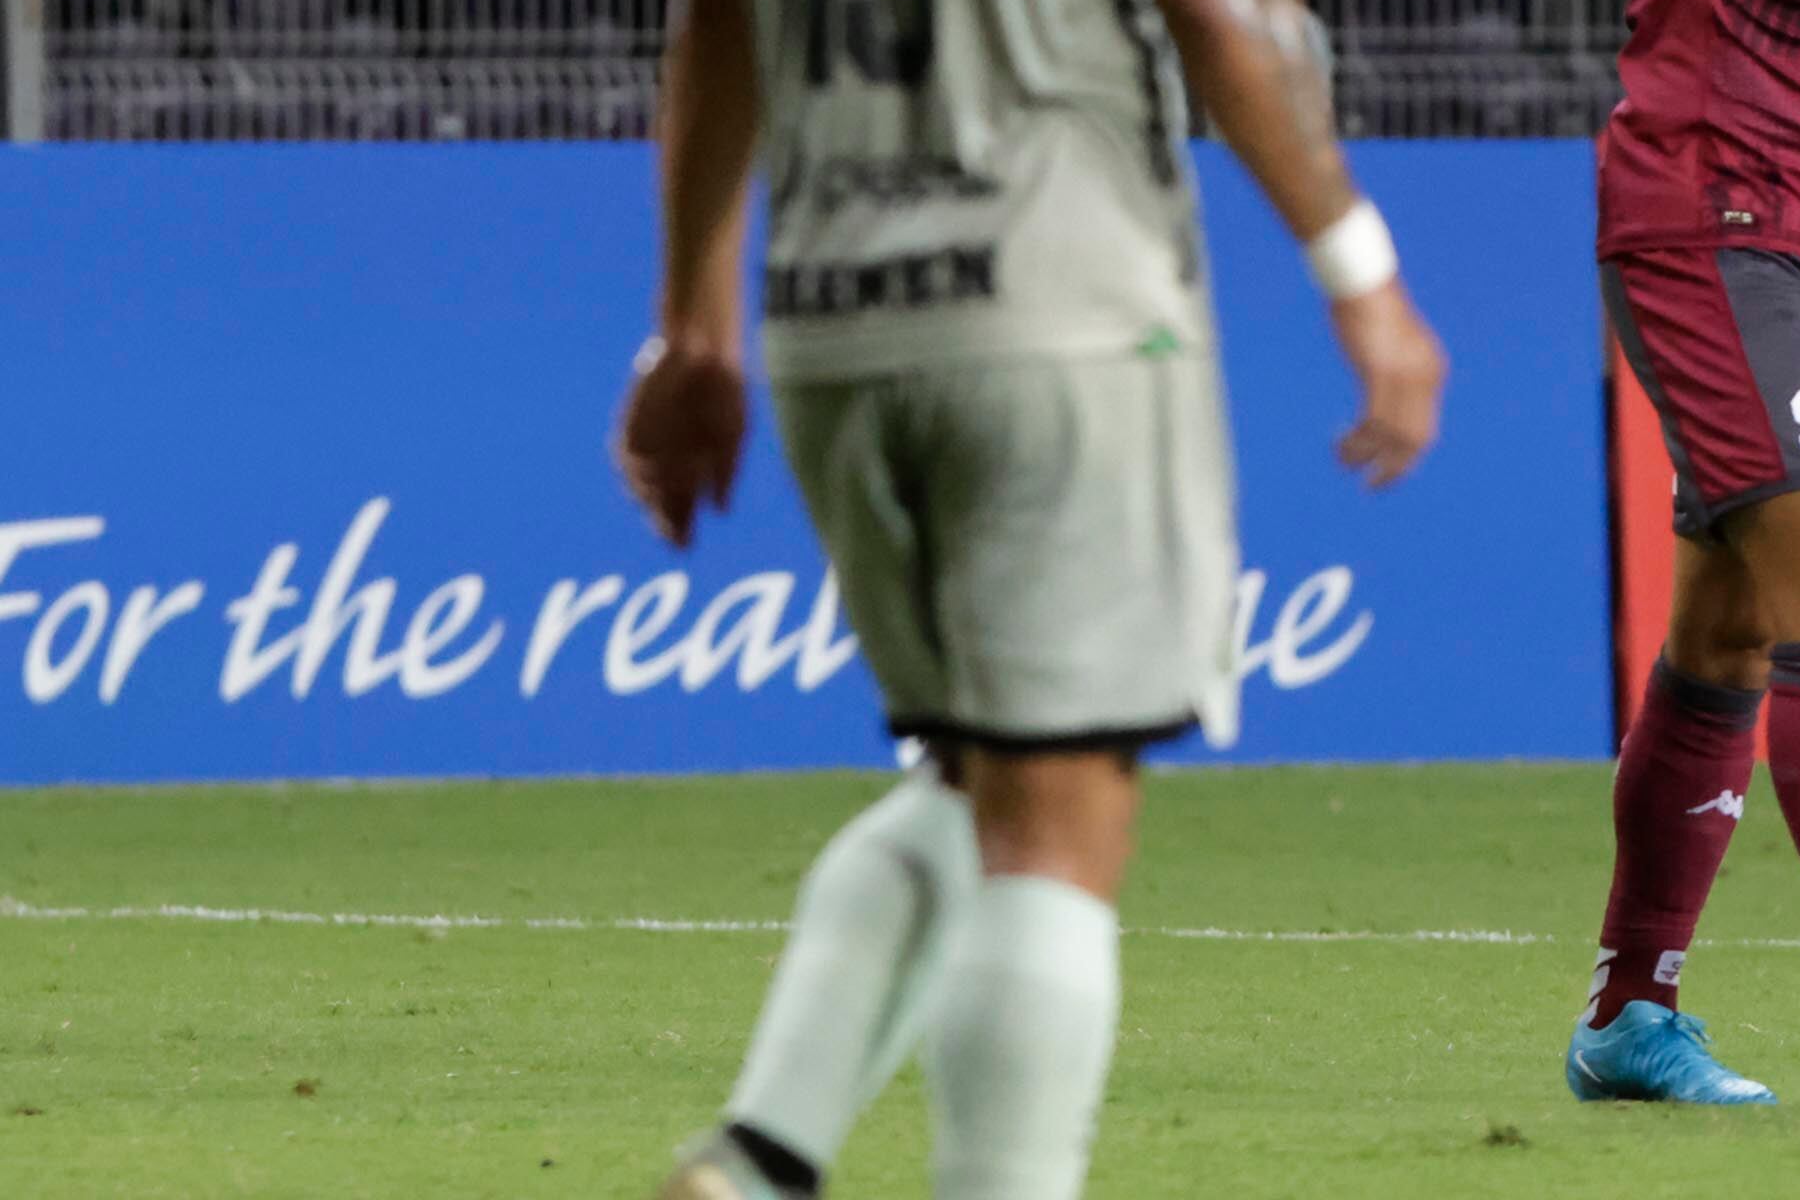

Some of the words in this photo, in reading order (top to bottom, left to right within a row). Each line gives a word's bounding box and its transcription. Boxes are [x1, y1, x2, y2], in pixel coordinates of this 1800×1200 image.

[0, 516, 203, 704] For
[218, 496, 505, 703] the
[519, 567, 867, 698] real
